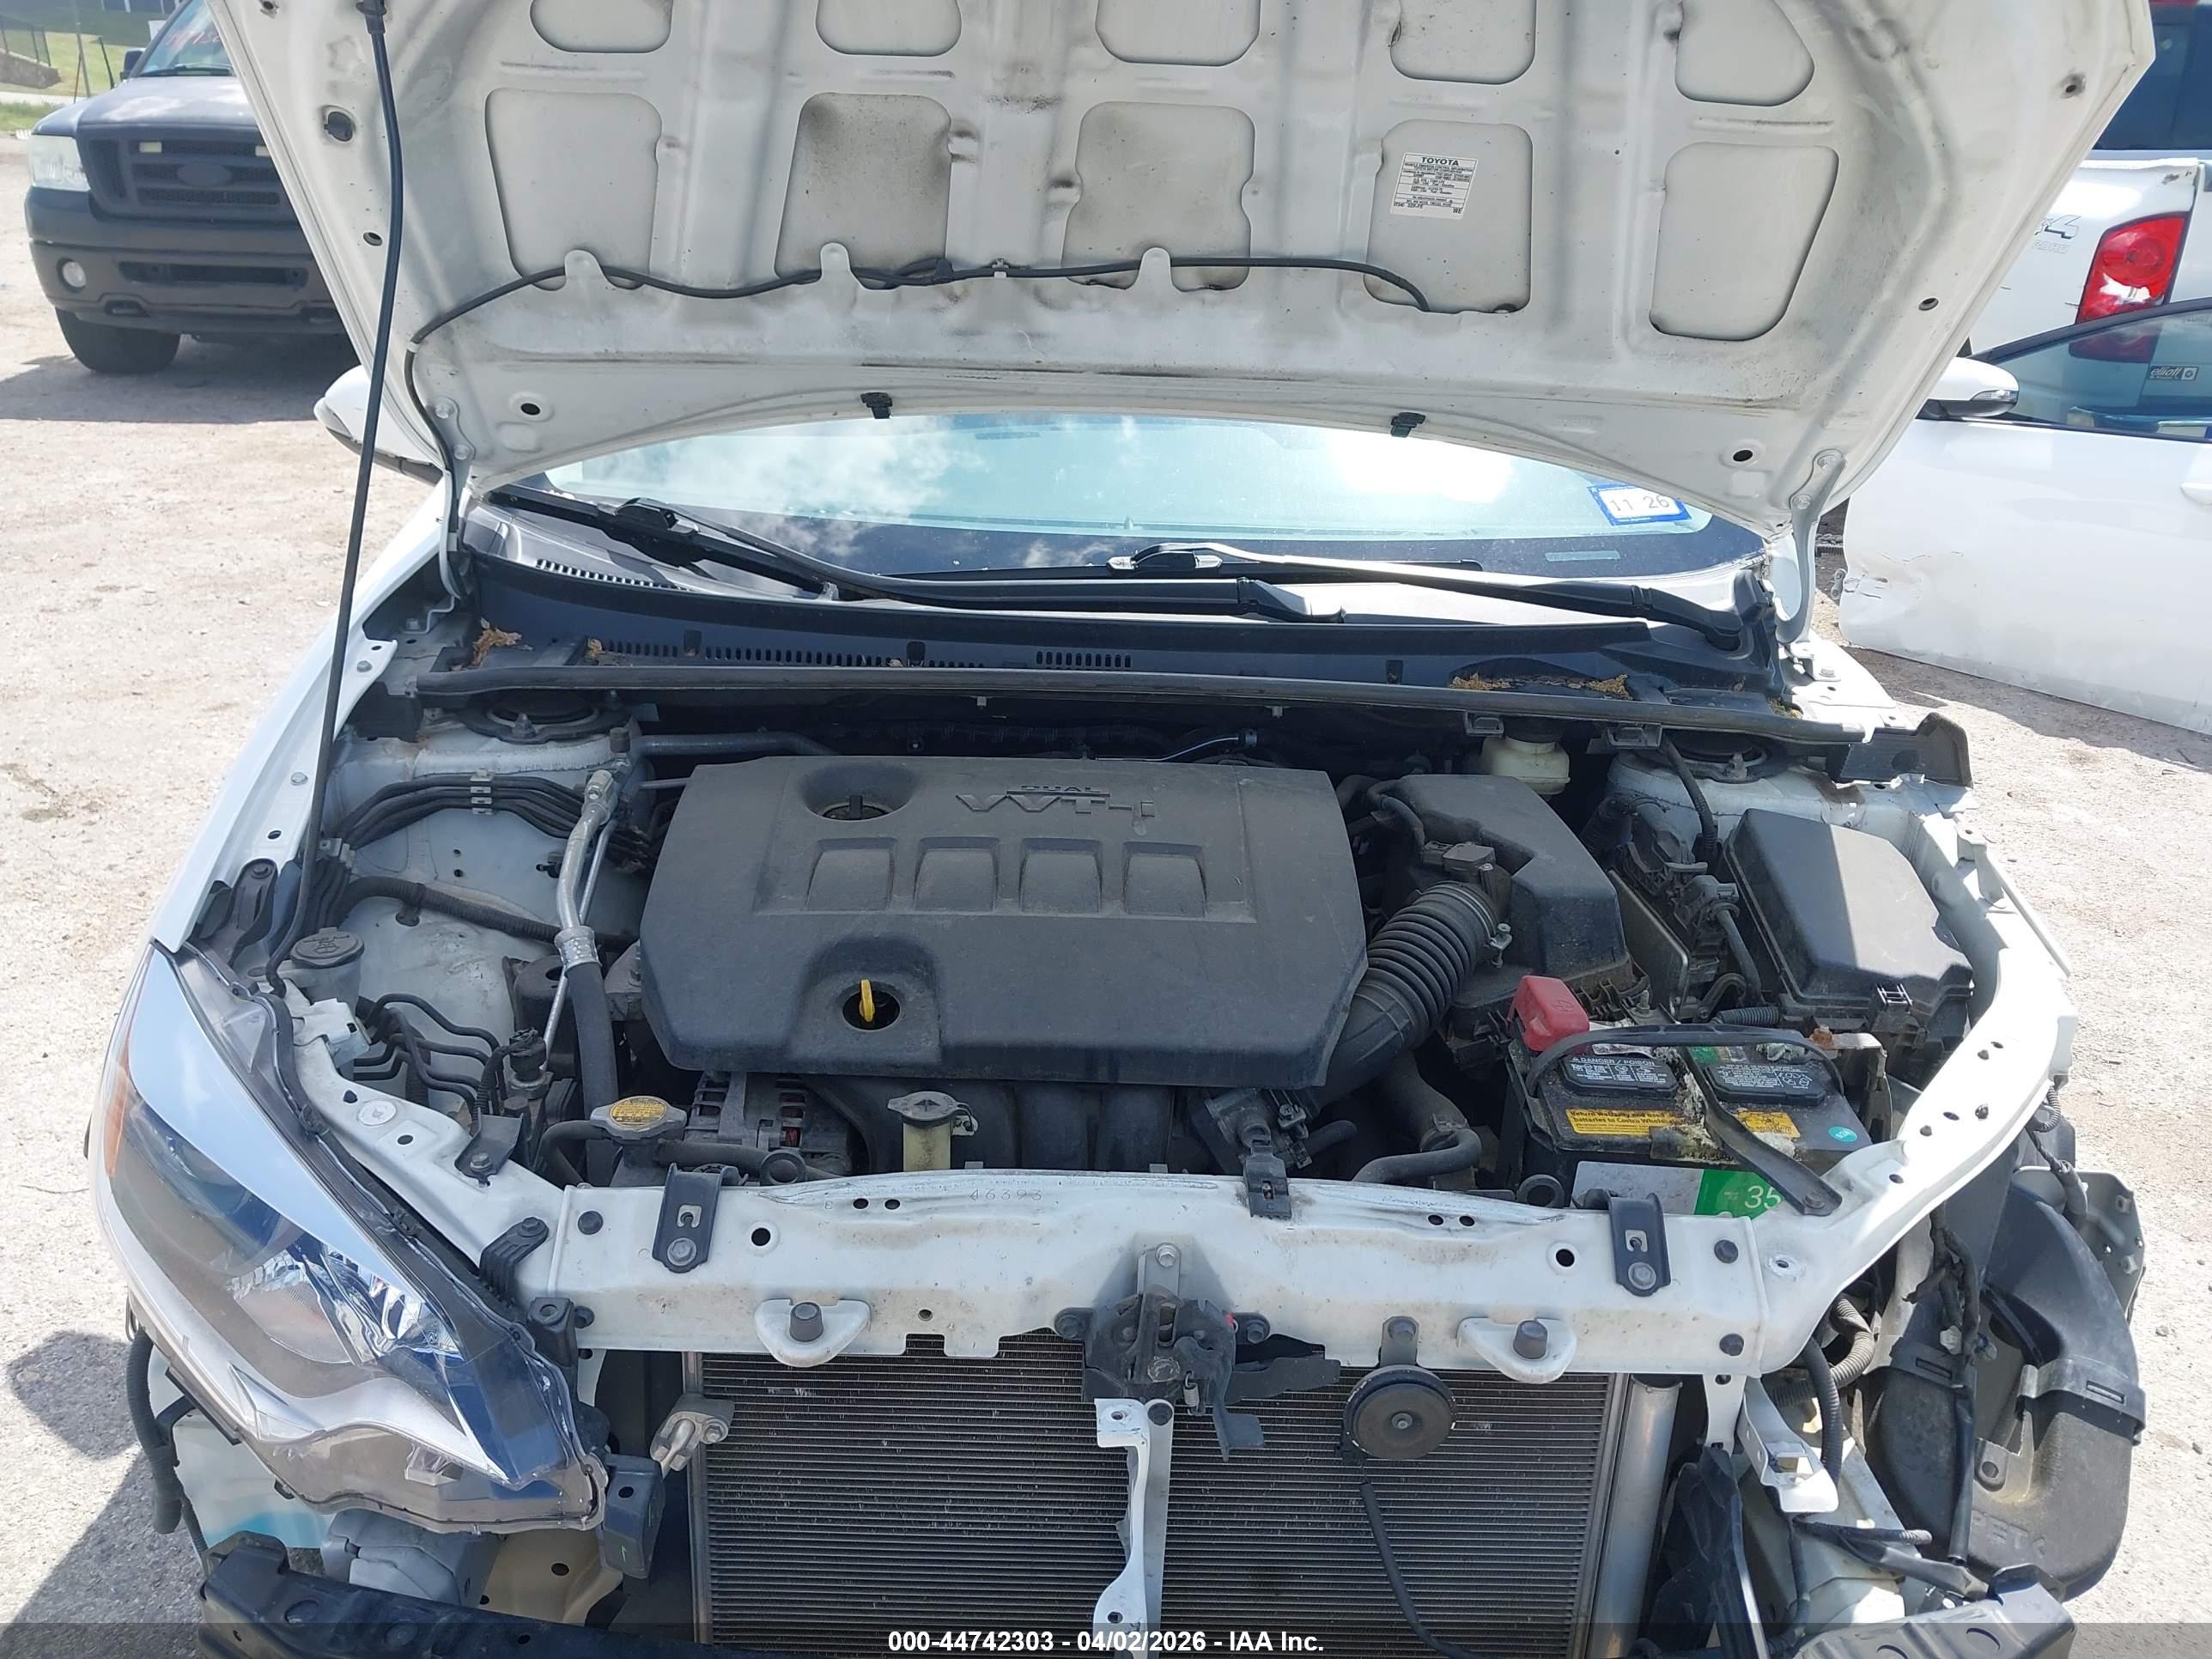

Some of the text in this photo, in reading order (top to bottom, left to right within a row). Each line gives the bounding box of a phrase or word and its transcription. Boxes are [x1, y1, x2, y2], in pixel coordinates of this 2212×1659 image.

[1422, 157, 1459, 166] TOYOTA
[1610, 495, 1670, 512] 11 26
[1744, 1185, 1781, 1209] 35
